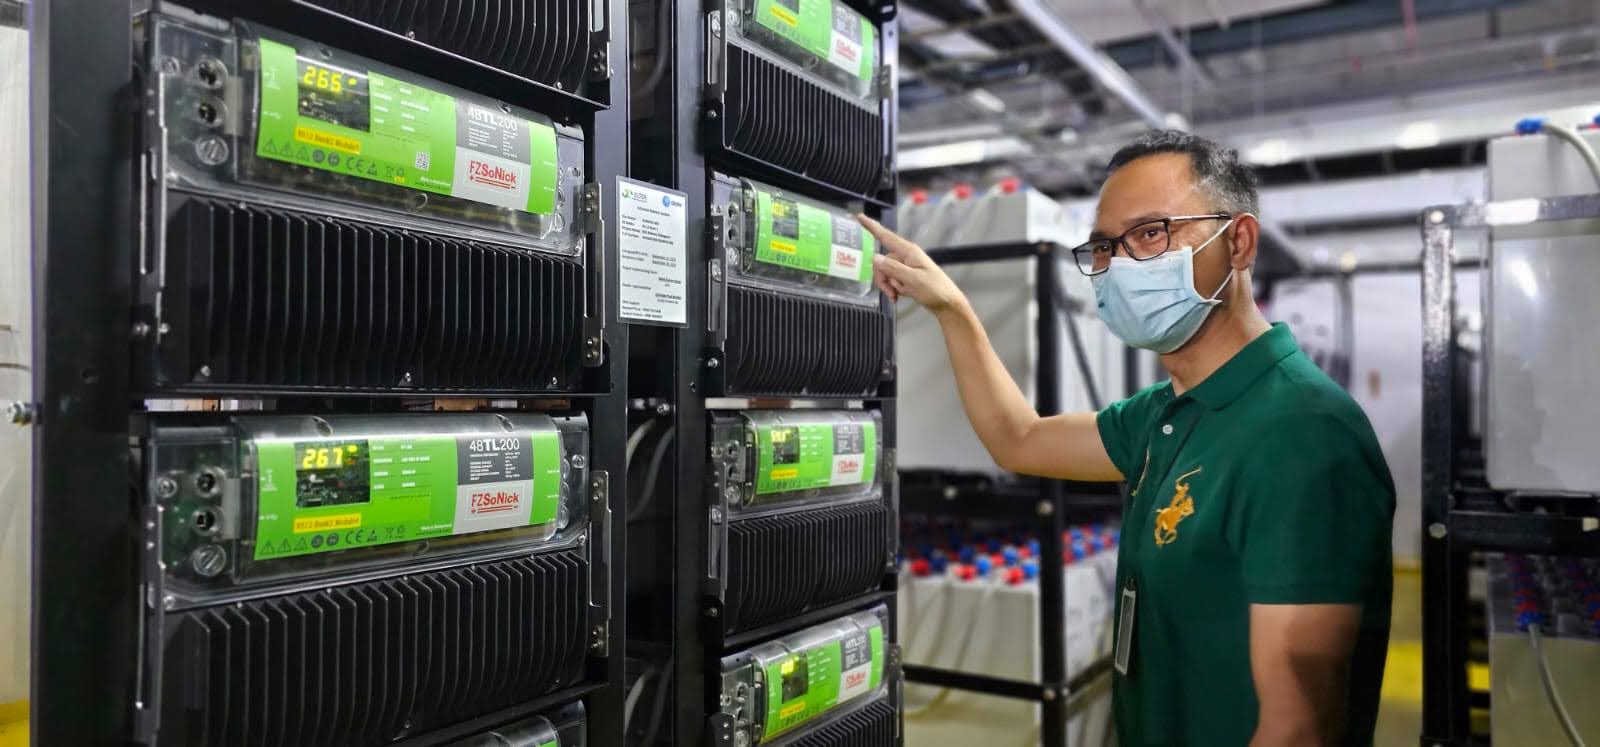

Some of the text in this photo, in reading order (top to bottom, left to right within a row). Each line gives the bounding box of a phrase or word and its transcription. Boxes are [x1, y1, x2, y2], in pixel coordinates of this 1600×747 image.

[467, 106, 518, 130] 48TL200
[470, 160, 517, 184] FZSoNick
[469, 438, 520, 452] 48TL200
[303, 447, 343, 469] 267
[471, 492, 520, 507] FZSoNick
